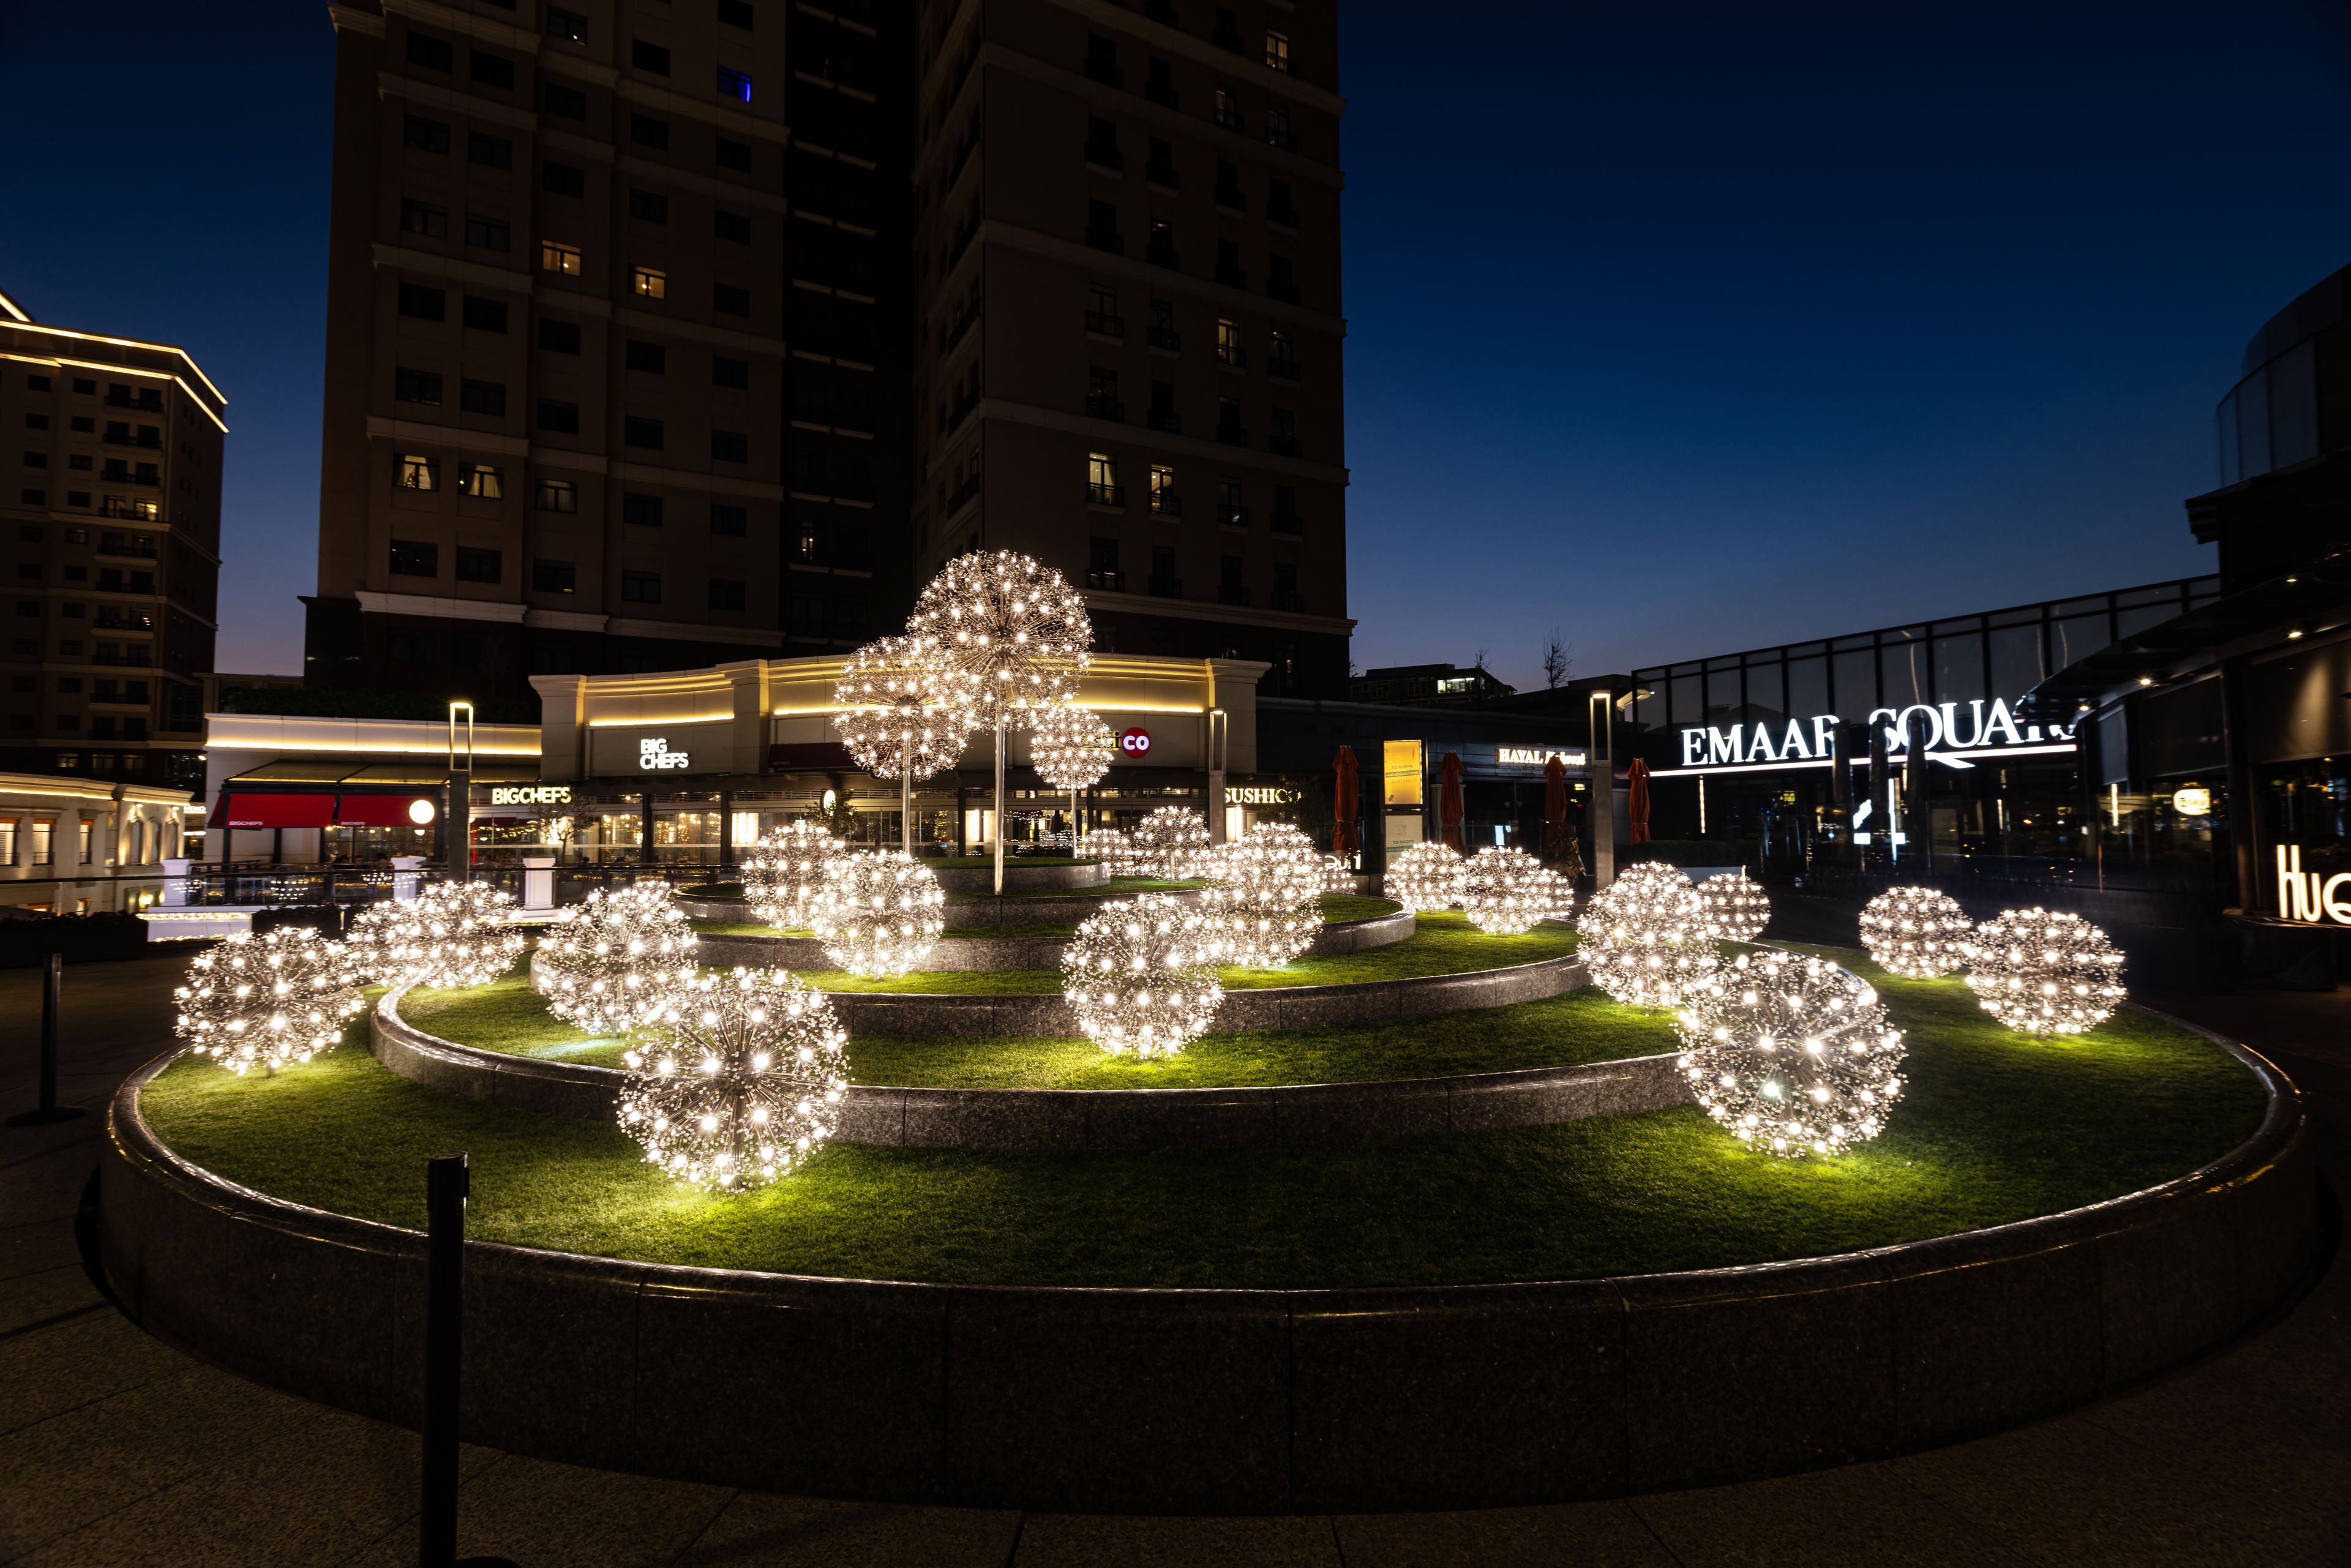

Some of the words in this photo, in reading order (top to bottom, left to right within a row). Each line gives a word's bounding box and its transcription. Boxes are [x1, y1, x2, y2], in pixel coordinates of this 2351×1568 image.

[640, 738, 667, 754] BIG
[1681, 715, 1840, 765] EMAAR
[640, 752, 689, 769] CHEFS
[1499, 749, 1543, 763] HAYAL
[492, 787, 571, 804] BIGCHEFS
